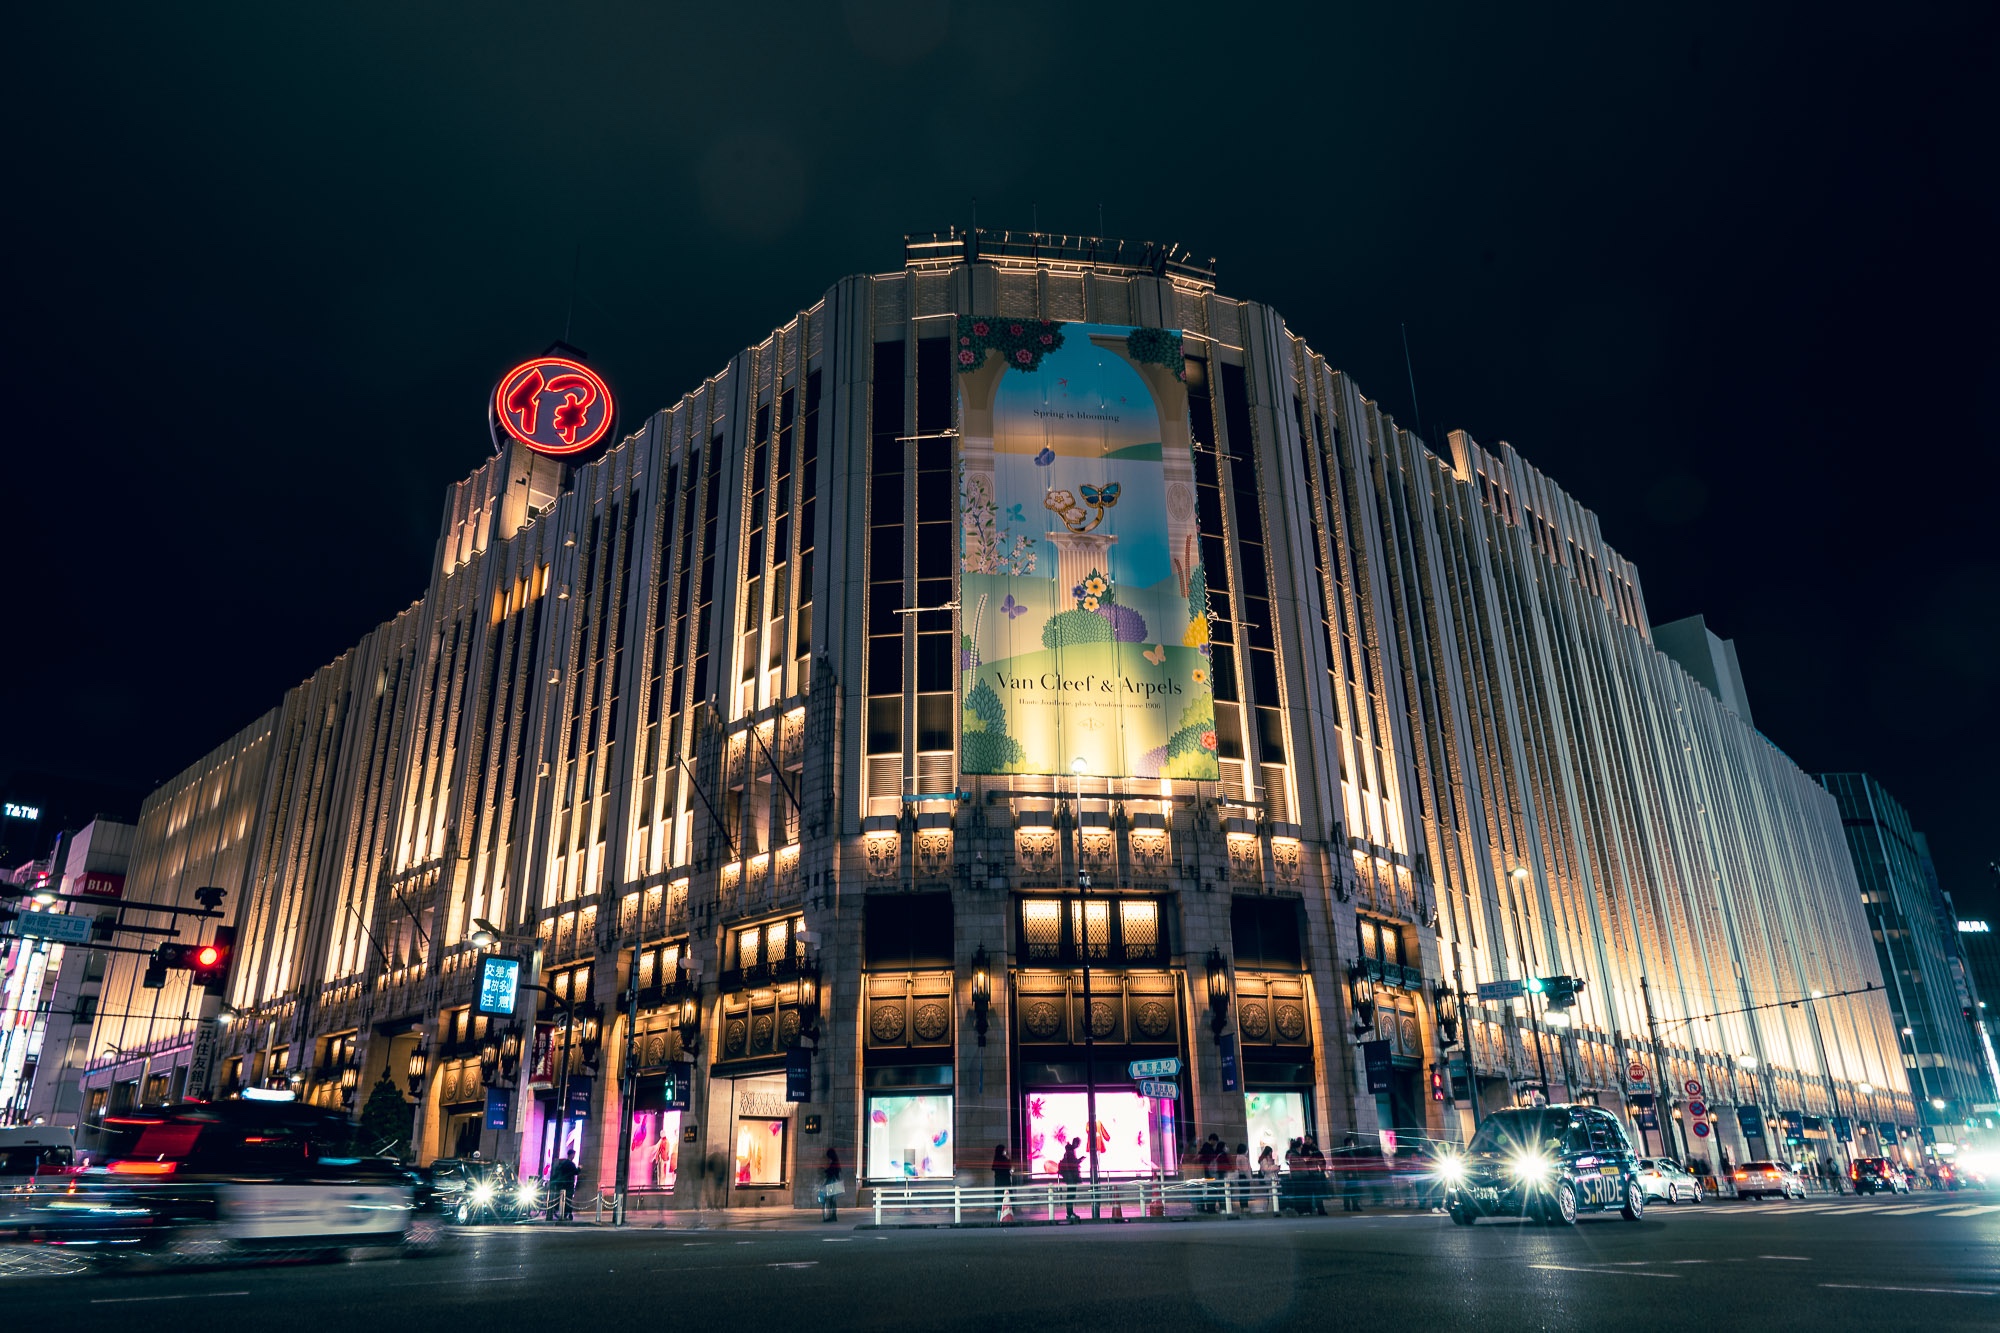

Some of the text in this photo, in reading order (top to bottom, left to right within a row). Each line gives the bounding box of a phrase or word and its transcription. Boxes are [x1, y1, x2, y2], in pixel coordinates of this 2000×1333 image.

[1033, 409, 1064, 419] Spring
[1077, 411, 1120, 423] blooming
[996, 672, 1182, 699] Van Cleef & Arpels
[87, 879, 114, 893] BLD.
[24, 914, 86, 931] 新宿三丁目
[189, 1016, 214, 1096] 三井住友銀行
[1583, 1175, 1623, 1205] S.RIDE
